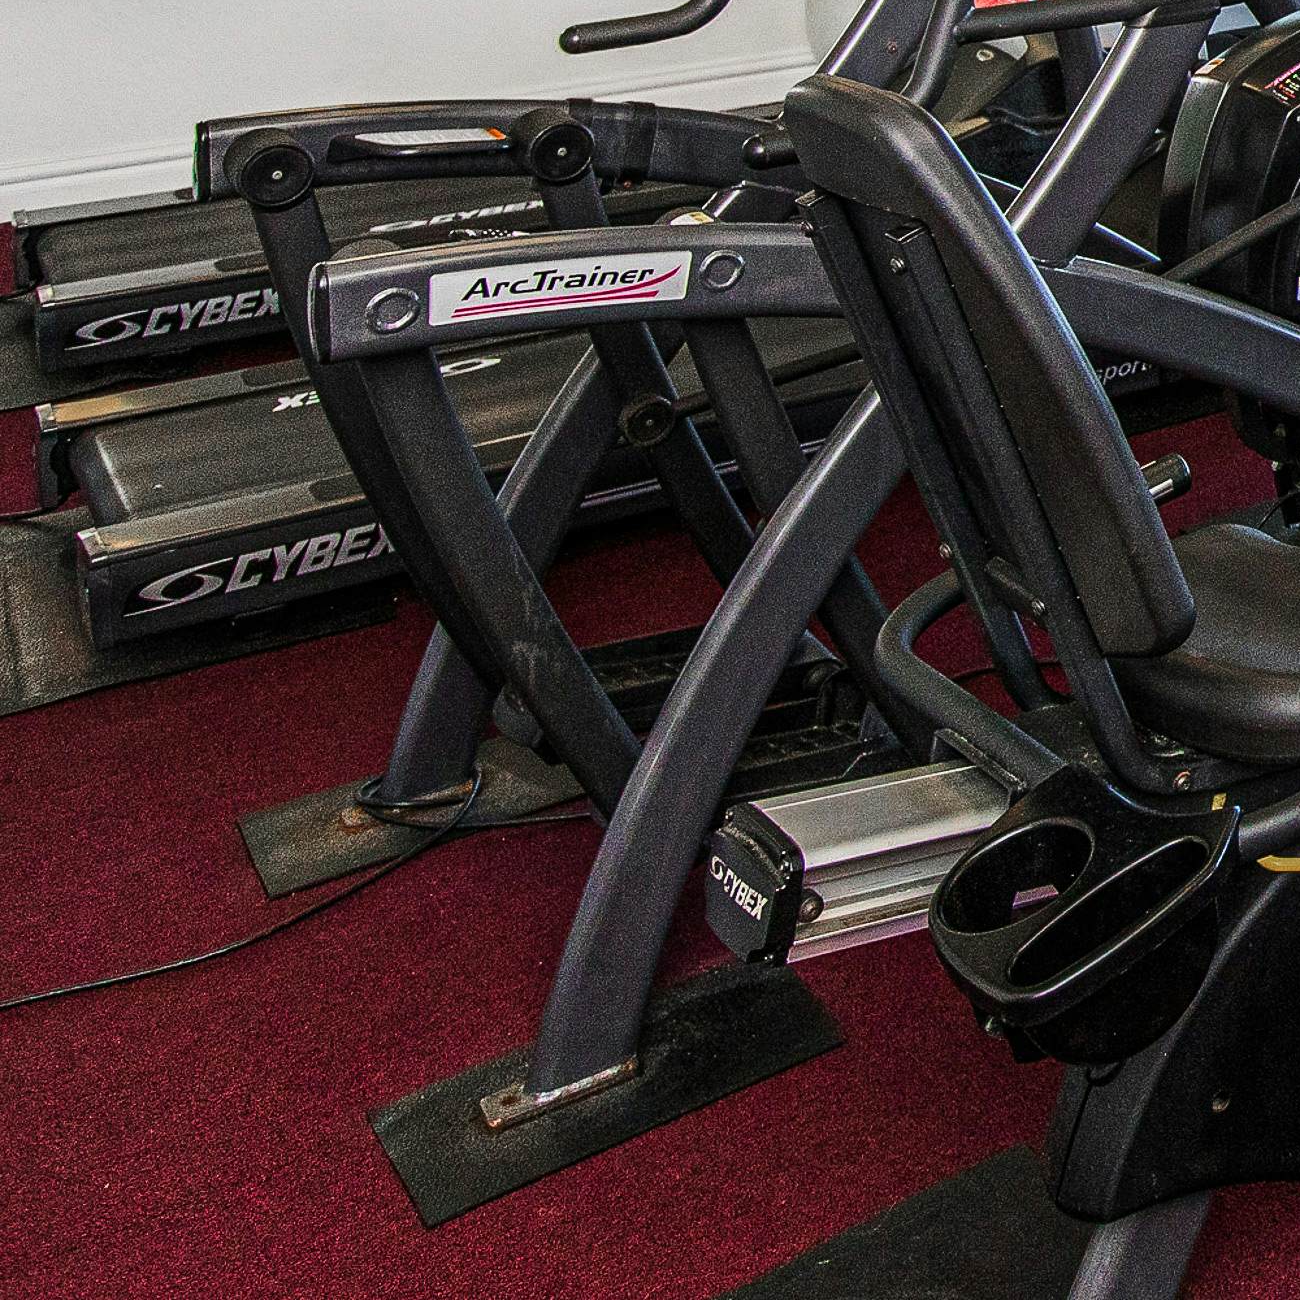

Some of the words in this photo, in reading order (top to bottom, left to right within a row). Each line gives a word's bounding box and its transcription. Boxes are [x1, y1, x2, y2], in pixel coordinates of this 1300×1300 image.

[461, 266, 655, 301] ArcTrainer
[142, 288, 281, 338] CYBEX
[724, 868, 768, 921] CYBEX
